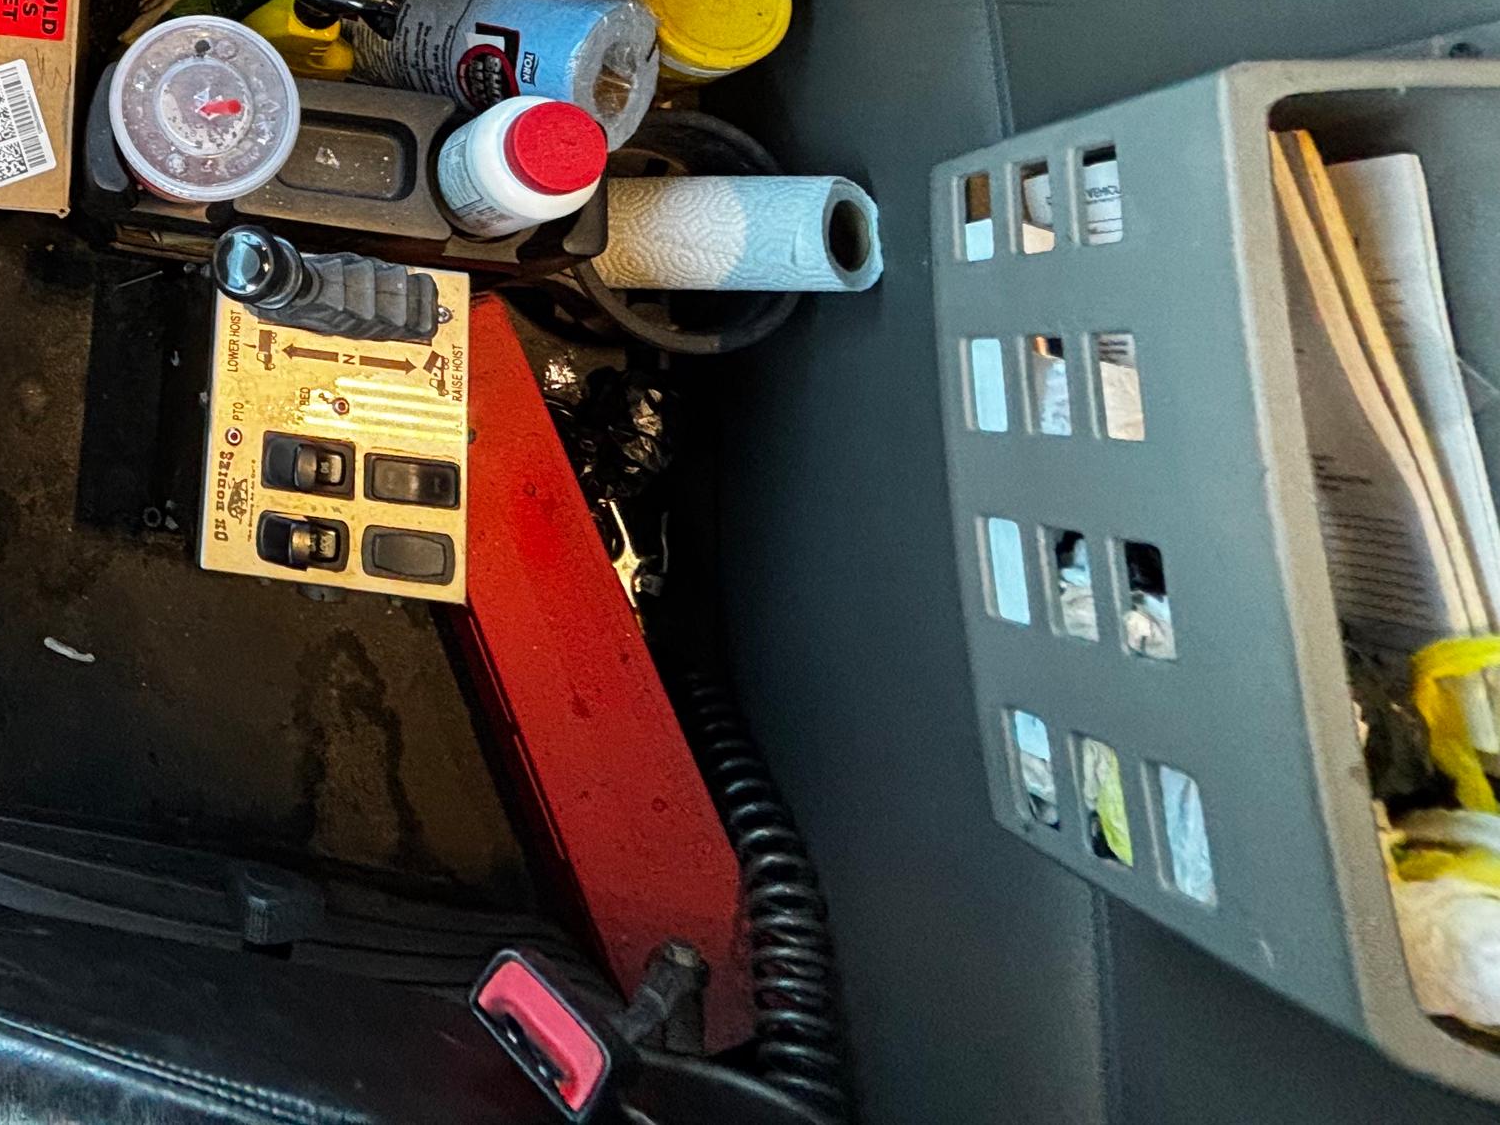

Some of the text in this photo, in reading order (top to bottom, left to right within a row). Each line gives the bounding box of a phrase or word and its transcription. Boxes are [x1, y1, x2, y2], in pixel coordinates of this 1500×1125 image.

[521, 51, 535, 84] TORK
[227, 309, 242, 373] LOWER HOIST
[451, 344, 464, 402] RAISE HOIST
[234, 402, 245, 422] PTO
[299, 386, 311, 406] BED
[214, 450, 235, 543] OX BODIES
